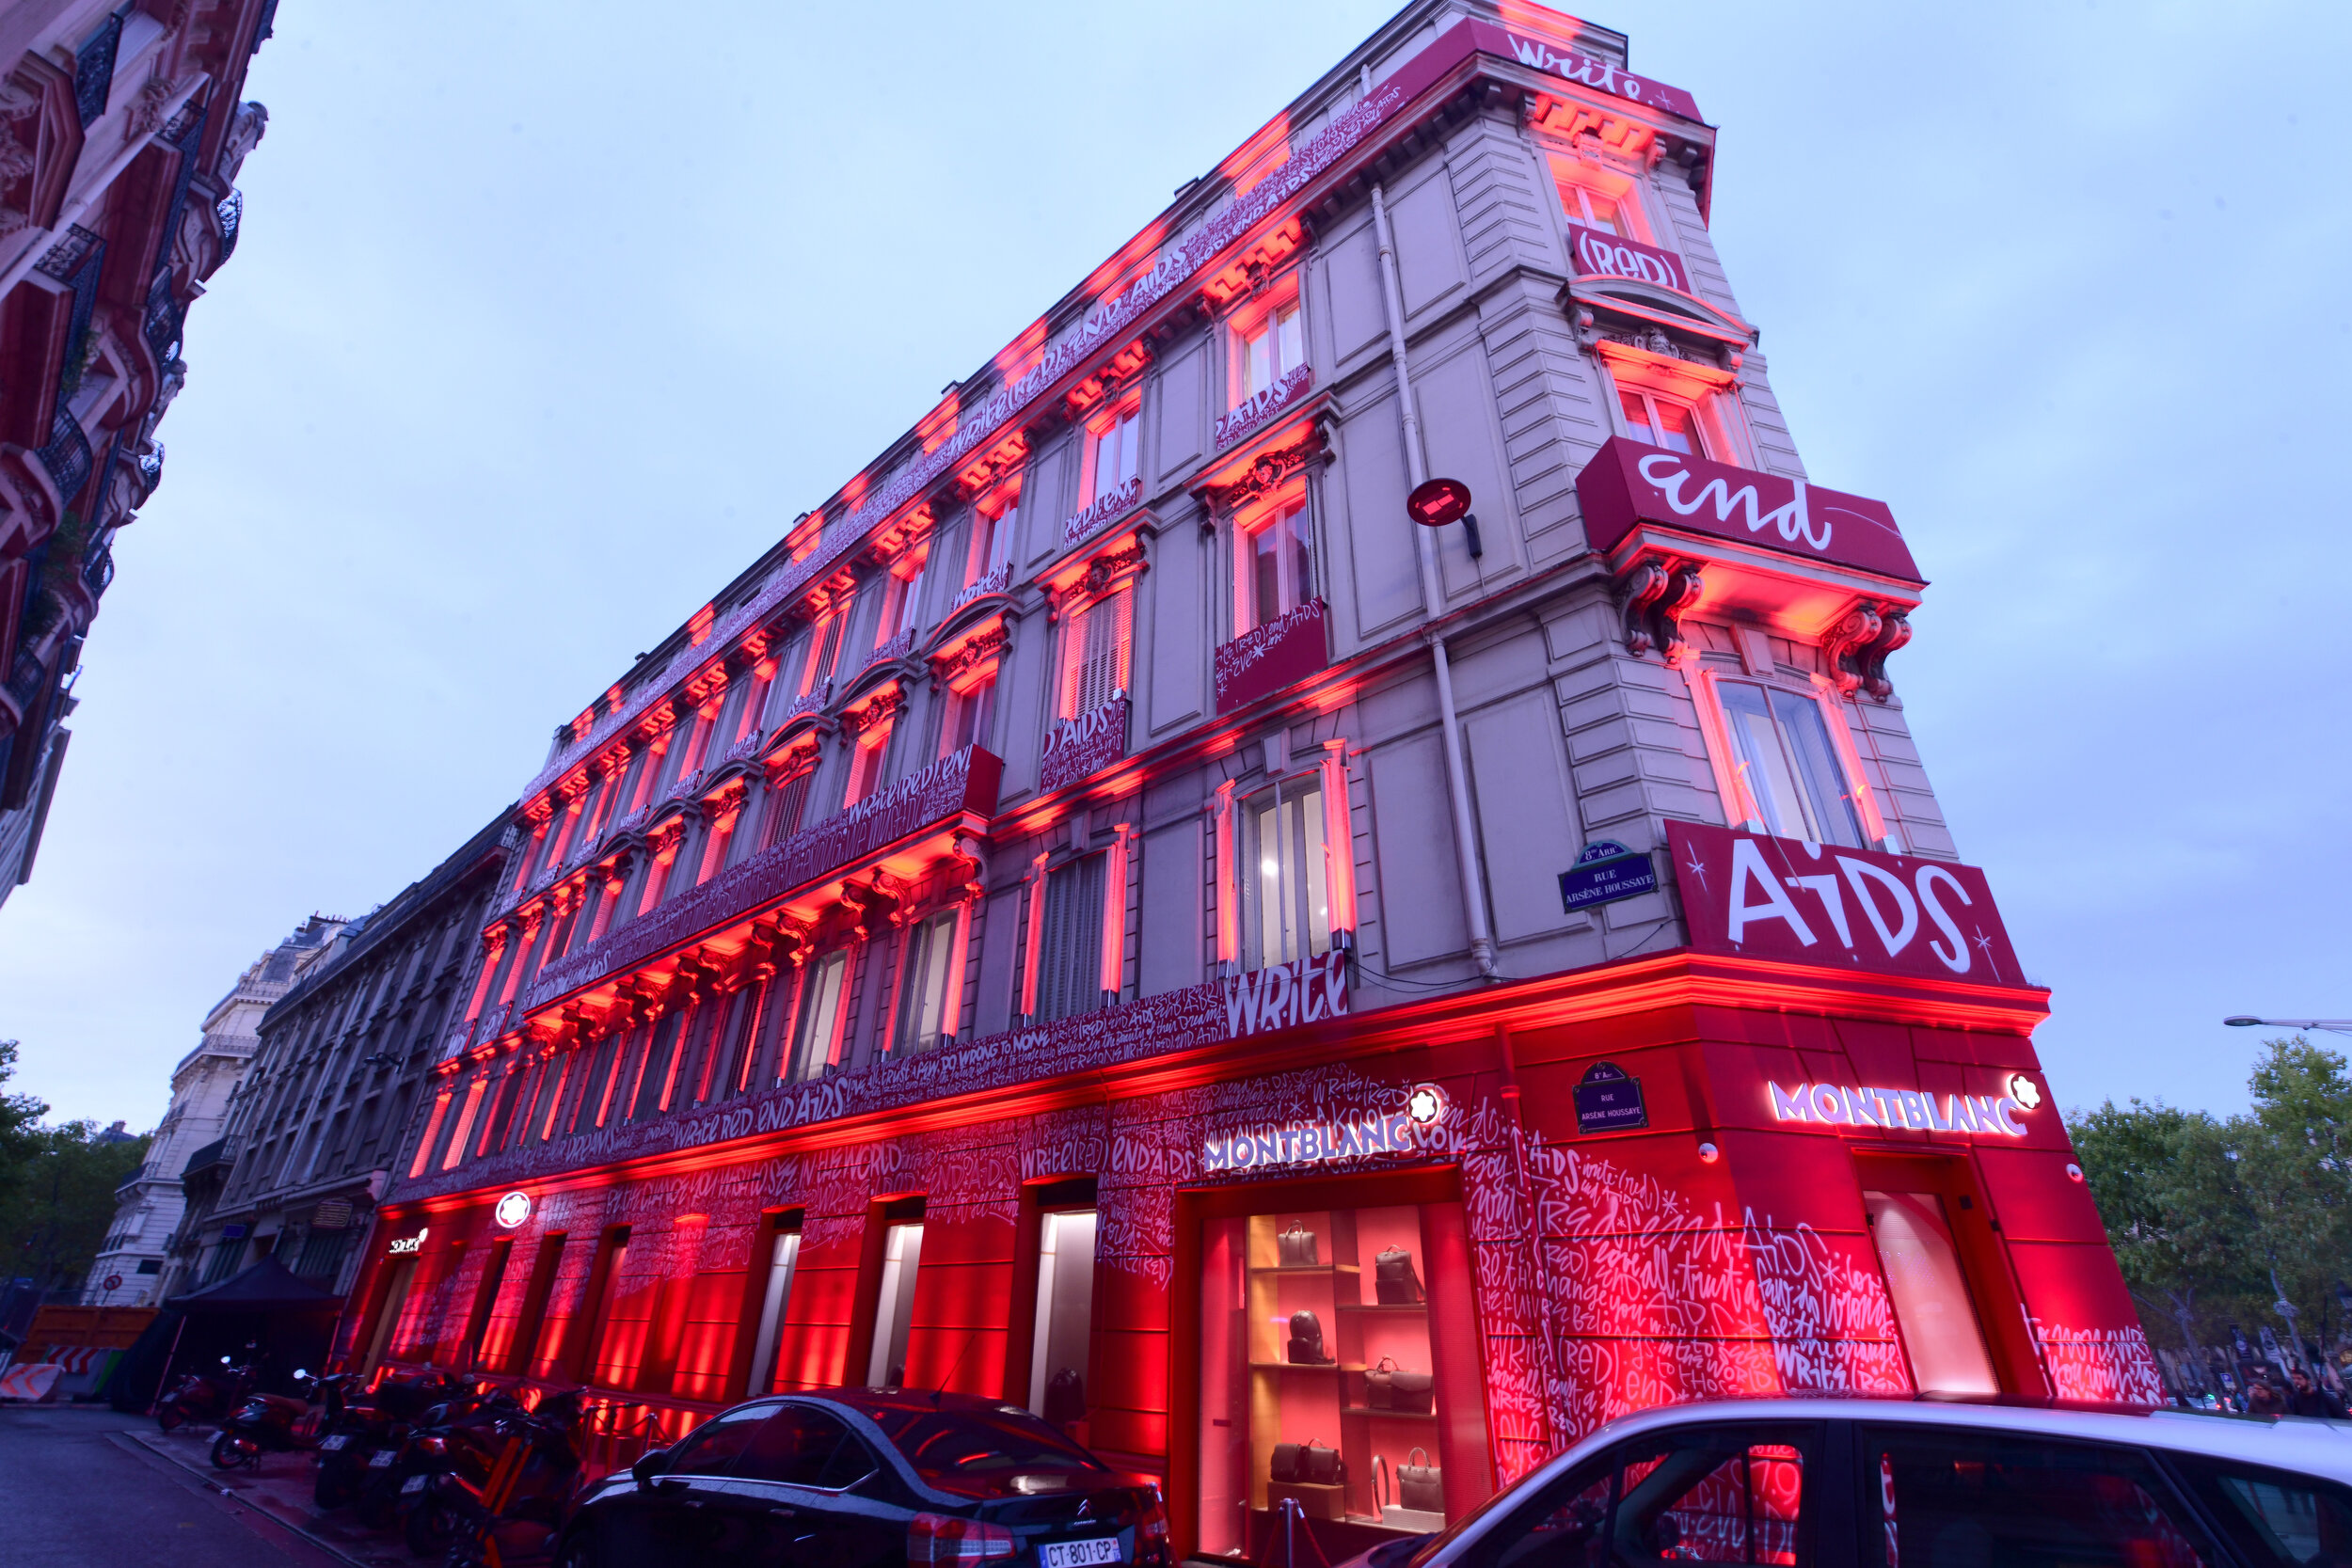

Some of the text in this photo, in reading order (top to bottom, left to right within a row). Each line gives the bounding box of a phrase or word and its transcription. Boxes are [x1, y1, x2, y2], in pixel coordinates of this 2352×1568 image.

[1594, 869, 1617, 883] RUE
[1604, 874, 1655, 894] HOUSSAYE
[1600, 1093, 1615, 1102] RUE
[1607, 1106, 1642, 1117] HOUSSAYE
[1769, 1080, 2028, 1137] MONTBLANC
[1204, 1117, 1411, 1172] MONTBLANC
[1048, 1541, 1111, 1567] CT-801-CP
